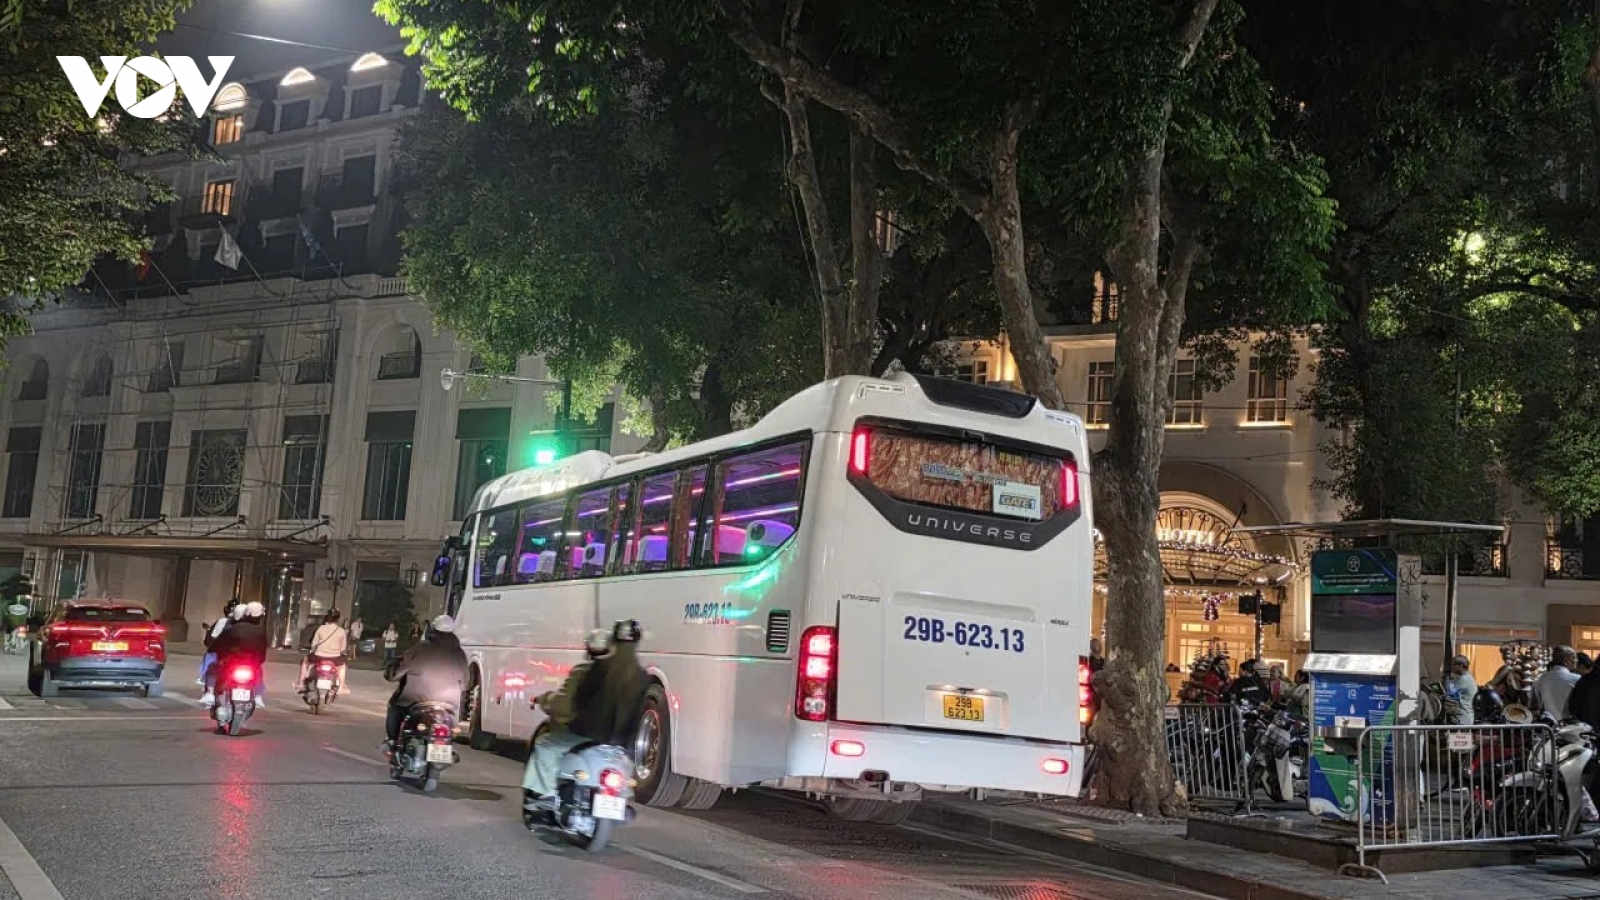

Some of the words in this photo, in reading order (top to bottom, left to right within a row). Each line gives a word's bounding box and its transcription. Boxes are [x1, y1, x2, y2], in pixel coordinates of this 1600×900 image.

[908, 513, 1032, 543] UNIVERSE
[903, 615, 1025, 653] 29B-623.13
[955, 696, 972, 708] 29B
